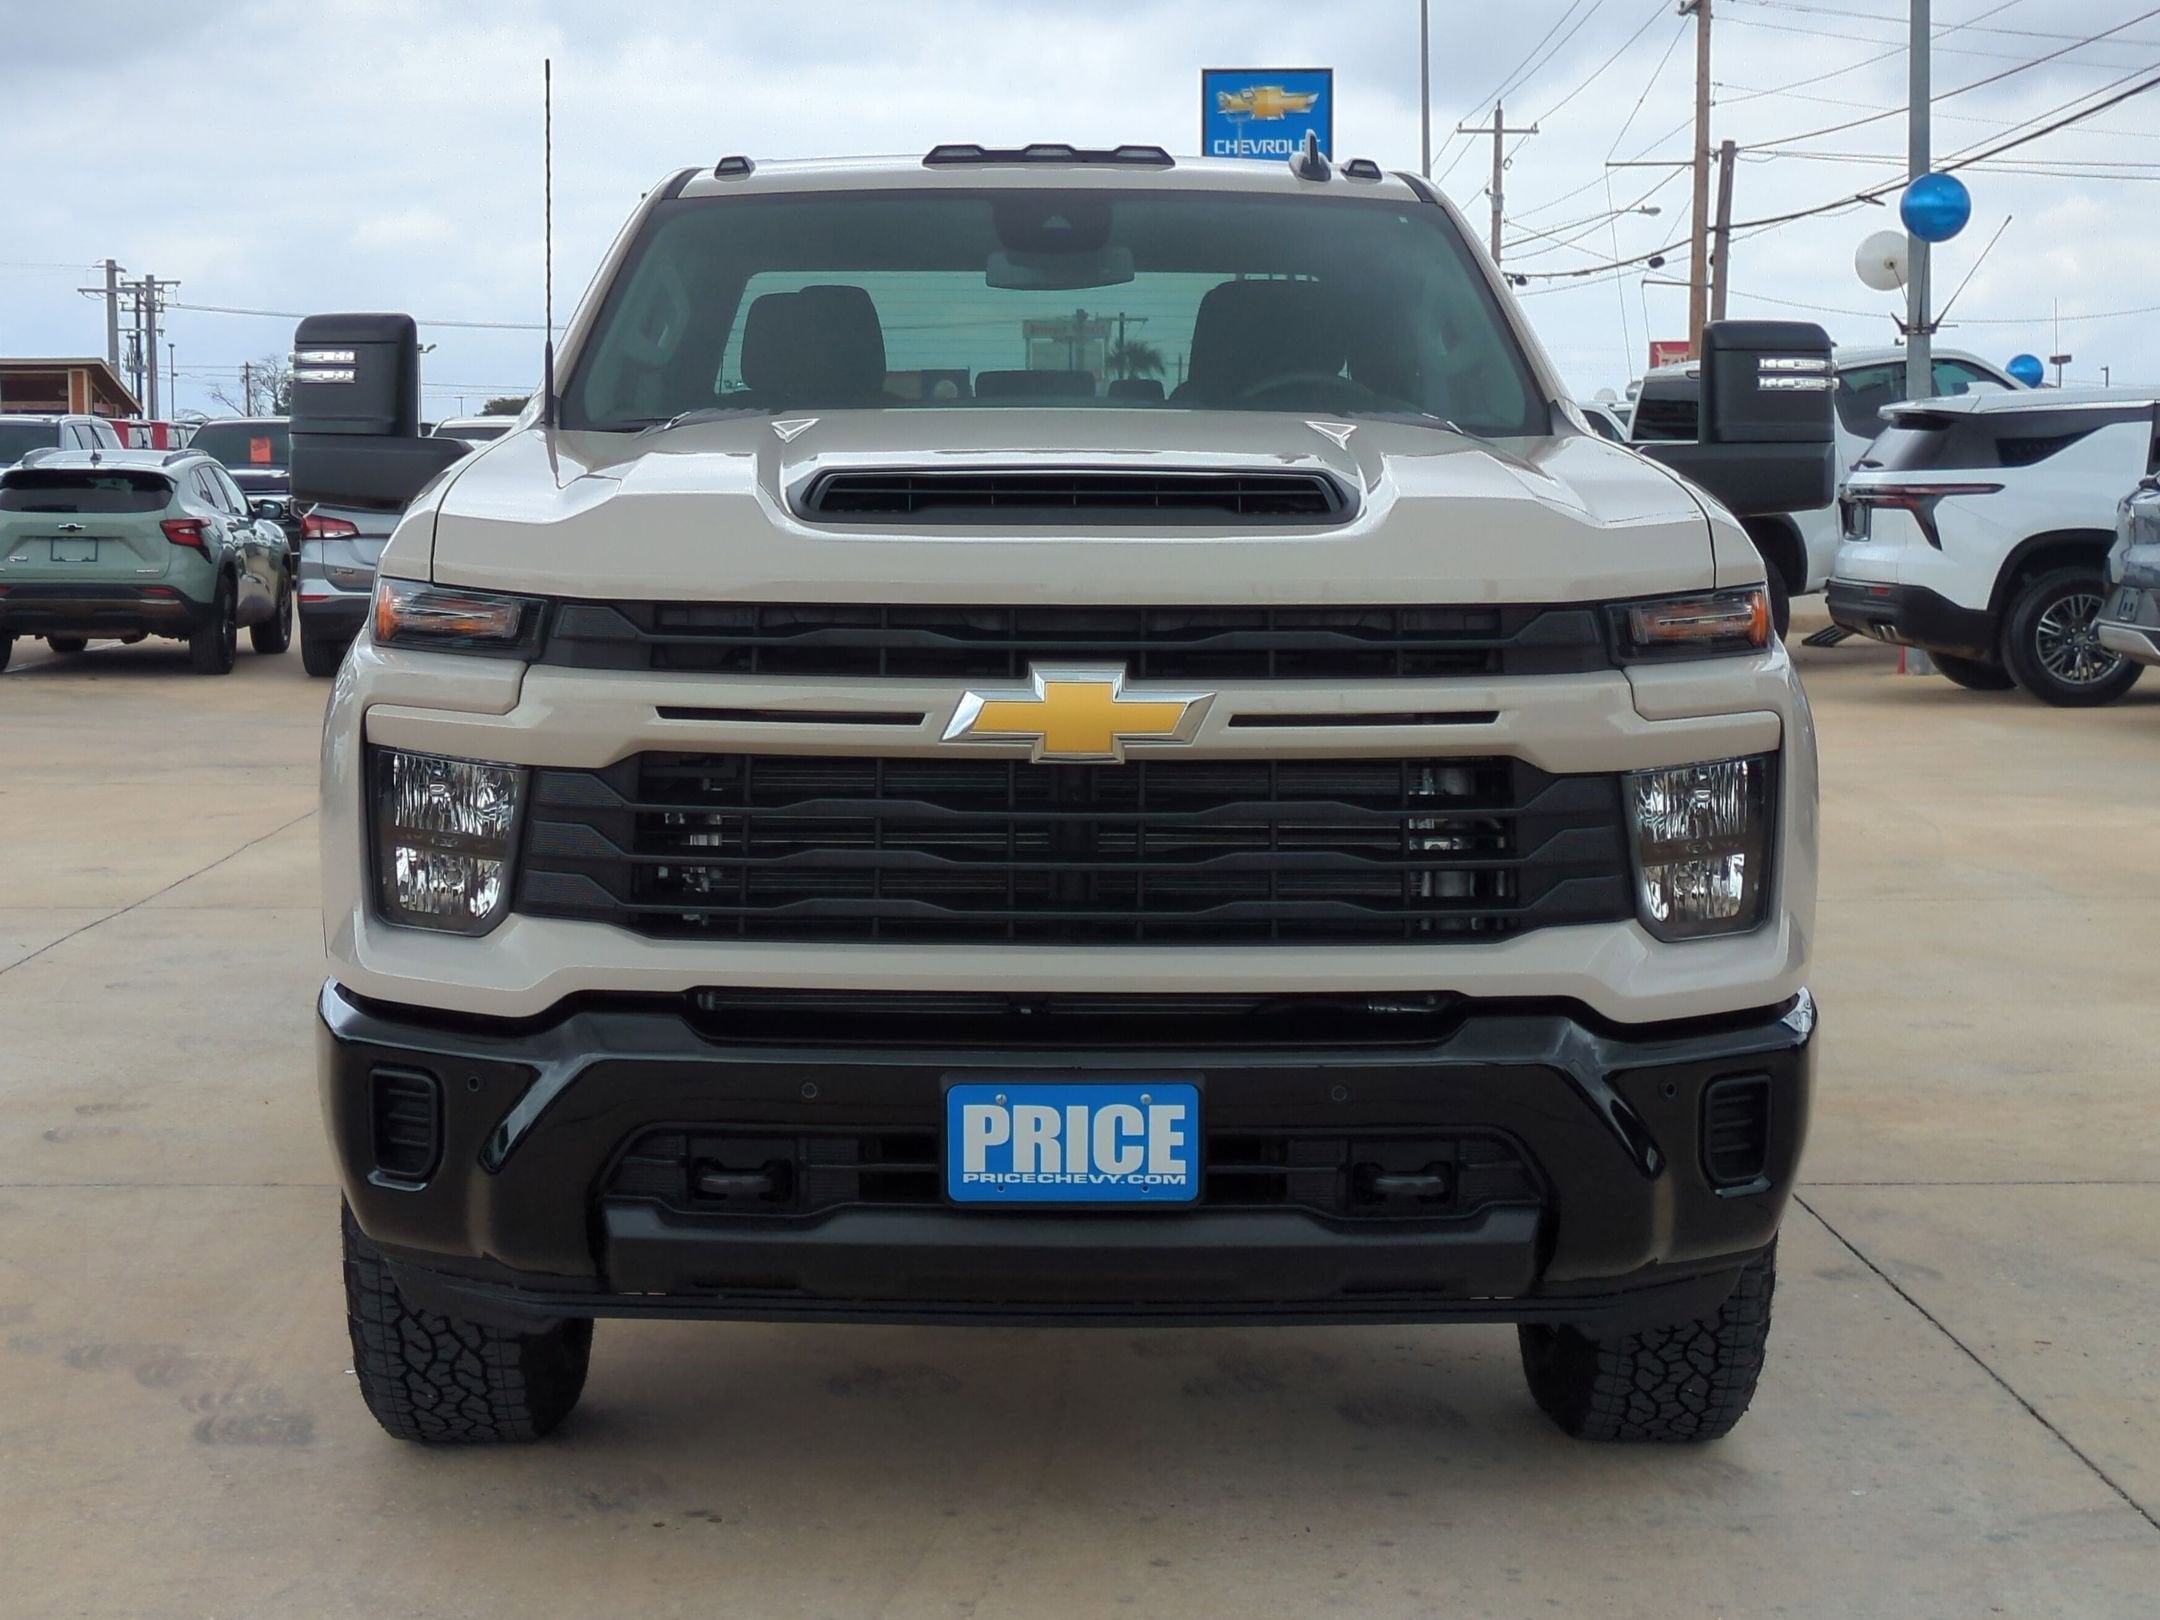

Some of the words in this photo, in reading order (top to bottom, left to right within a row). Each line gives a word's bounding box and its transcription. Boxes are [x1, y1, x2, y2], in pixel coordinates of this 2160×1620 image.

[1213, 139, 1321, 154] CHEVROLE
[963, 1104, 1187, 1175] PRICE
[963, 1173, 1187, 1184] PRICECHEVY.COM
